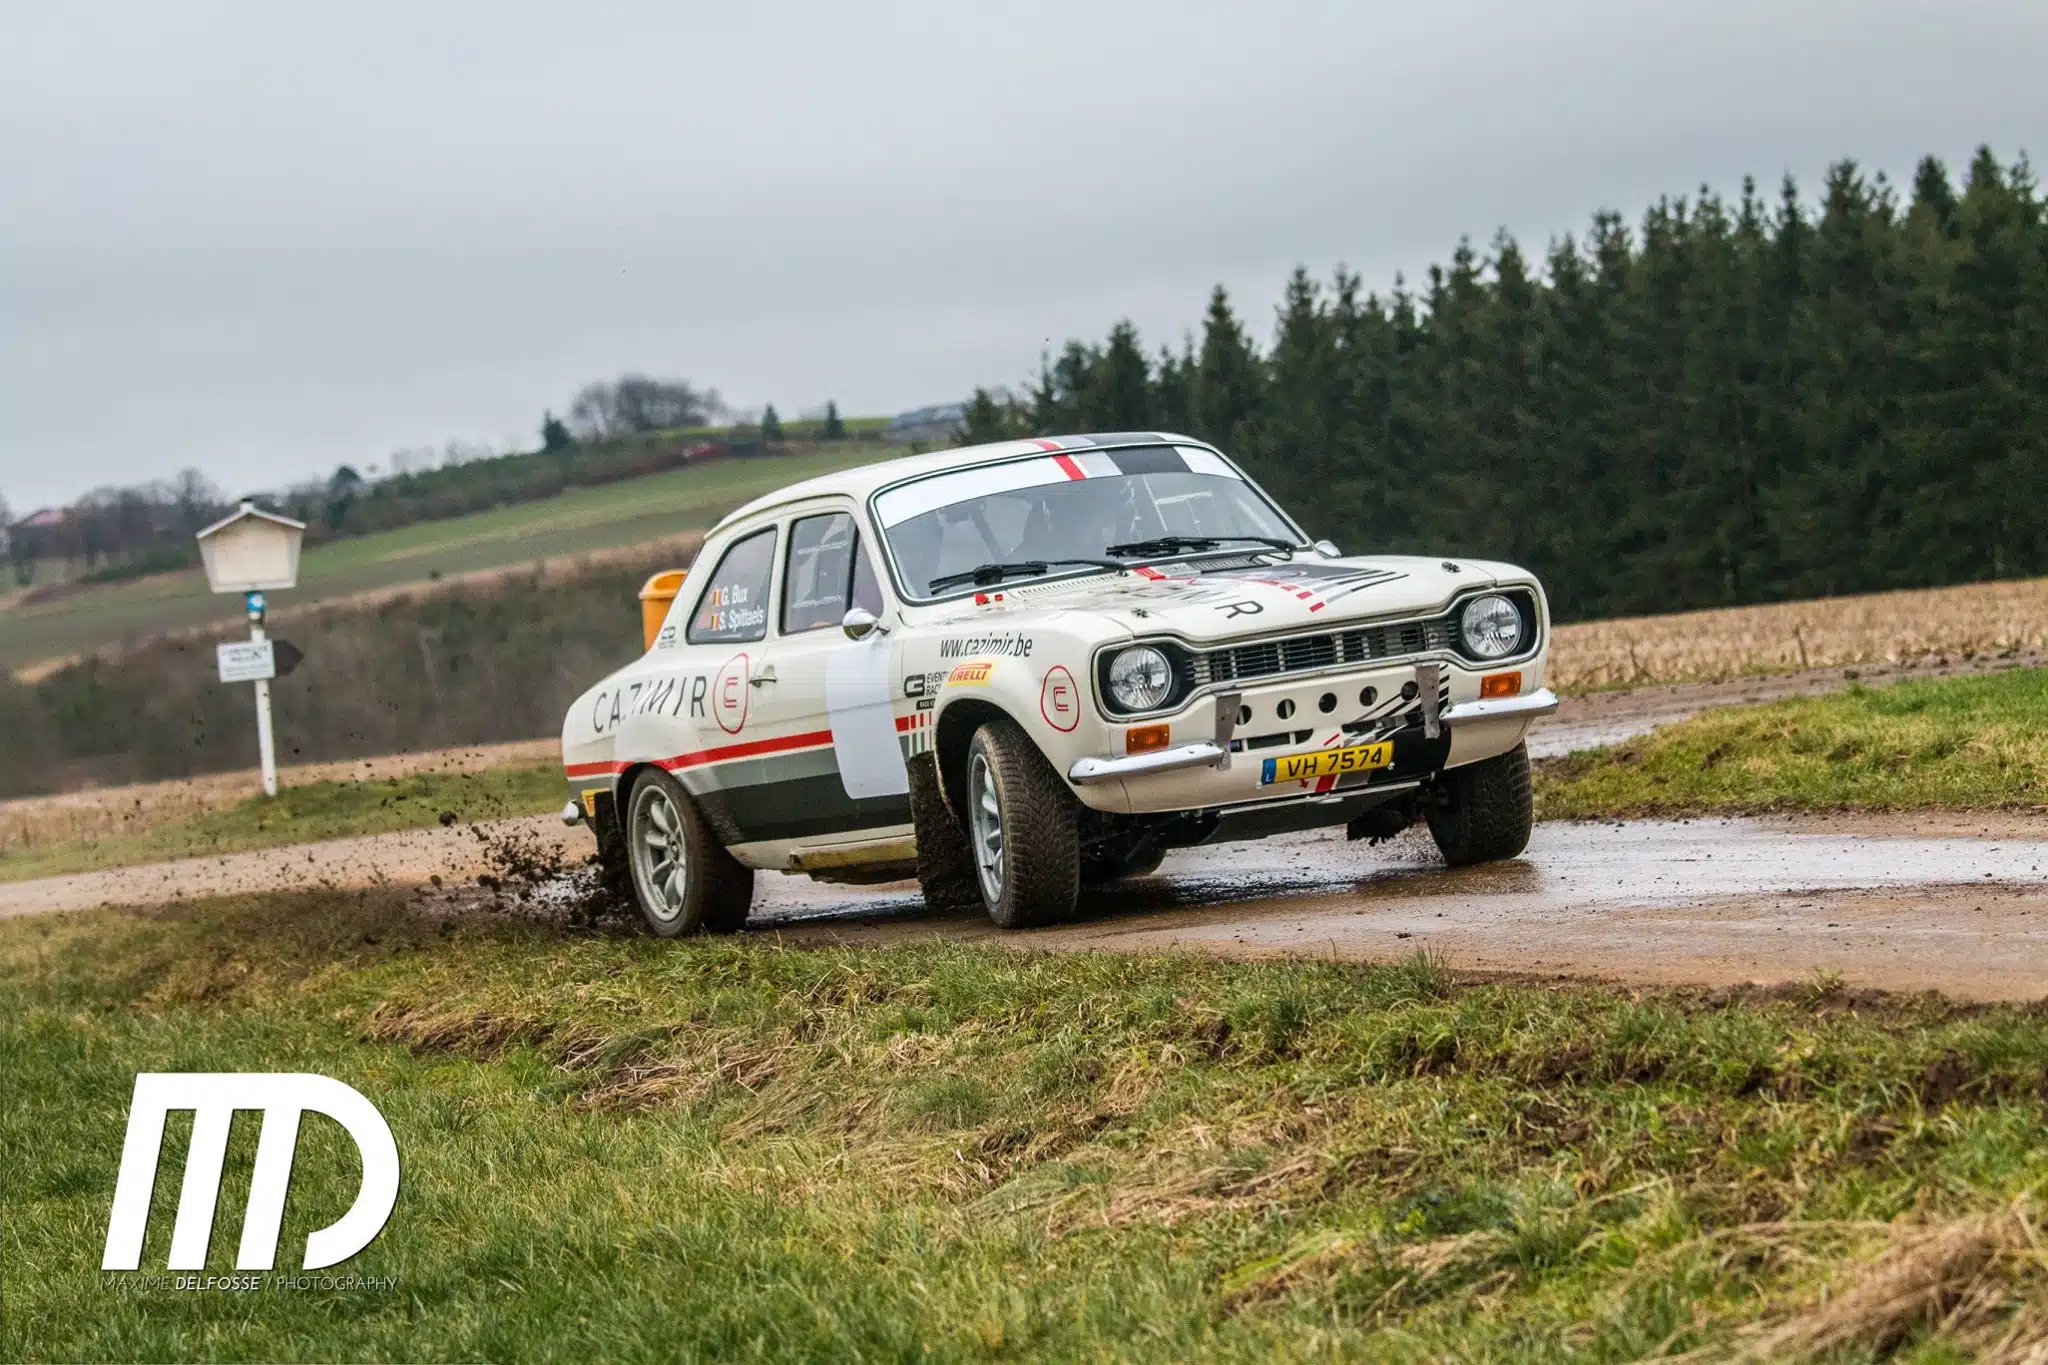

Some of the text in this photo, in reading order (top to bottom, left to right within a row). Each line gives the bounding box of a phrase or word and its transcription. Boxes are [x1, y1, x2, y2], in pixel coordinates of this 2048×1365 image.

[948, 663, 992, 683] PIRELLI
[1287, 746, 1383, 777] VH 7574
